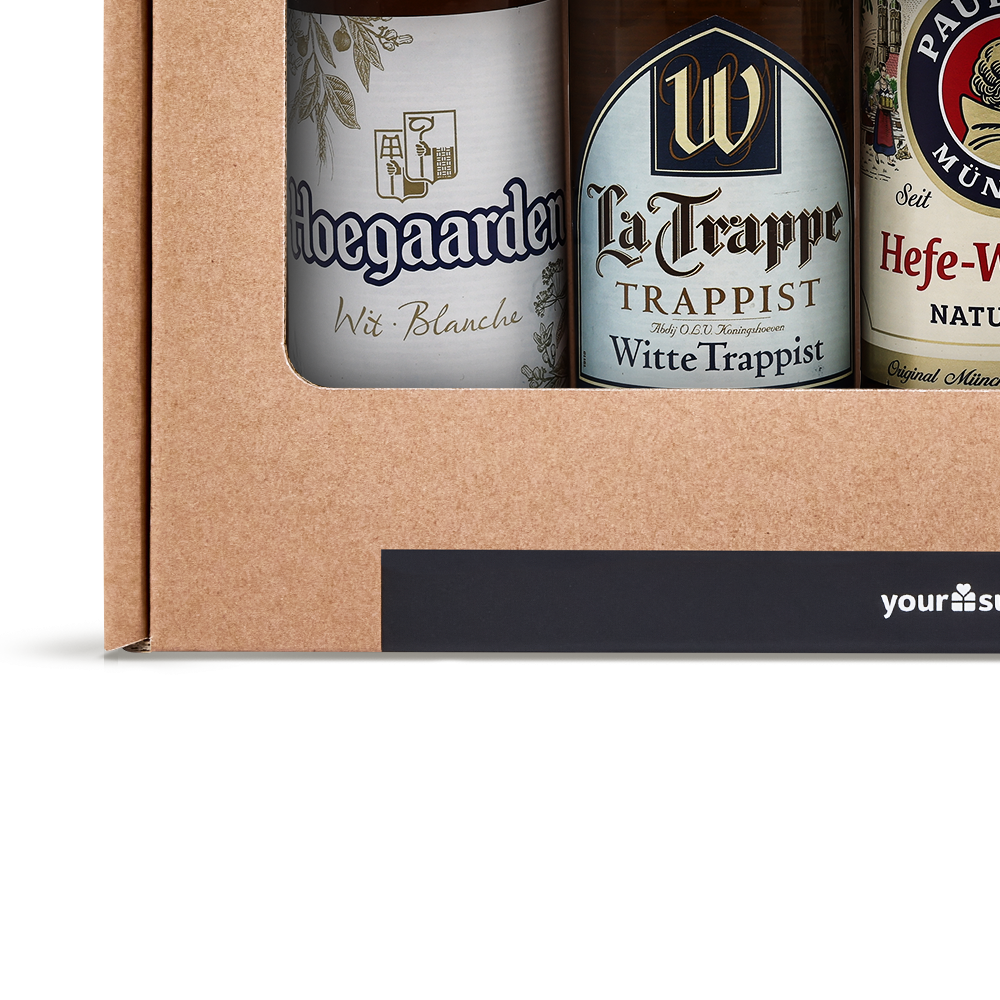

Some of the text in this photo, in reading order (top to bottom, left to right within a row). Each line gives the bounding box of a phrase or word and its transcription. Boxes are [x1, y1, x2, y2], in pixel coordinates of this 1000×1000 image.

[895, 181, 931, 210] Seit
[287, 175, 567, 287] Hoegaarden
[586, 183, 844, 278] La Trappe
[334, 296, 525, 341] Wit Blanche
[615, 277, 821, 316] TRAPPIST
[609, 335, 698, 372] Witte
[697, 336, 825, 379] Trappist
[887, 359, 942, 385] Original
